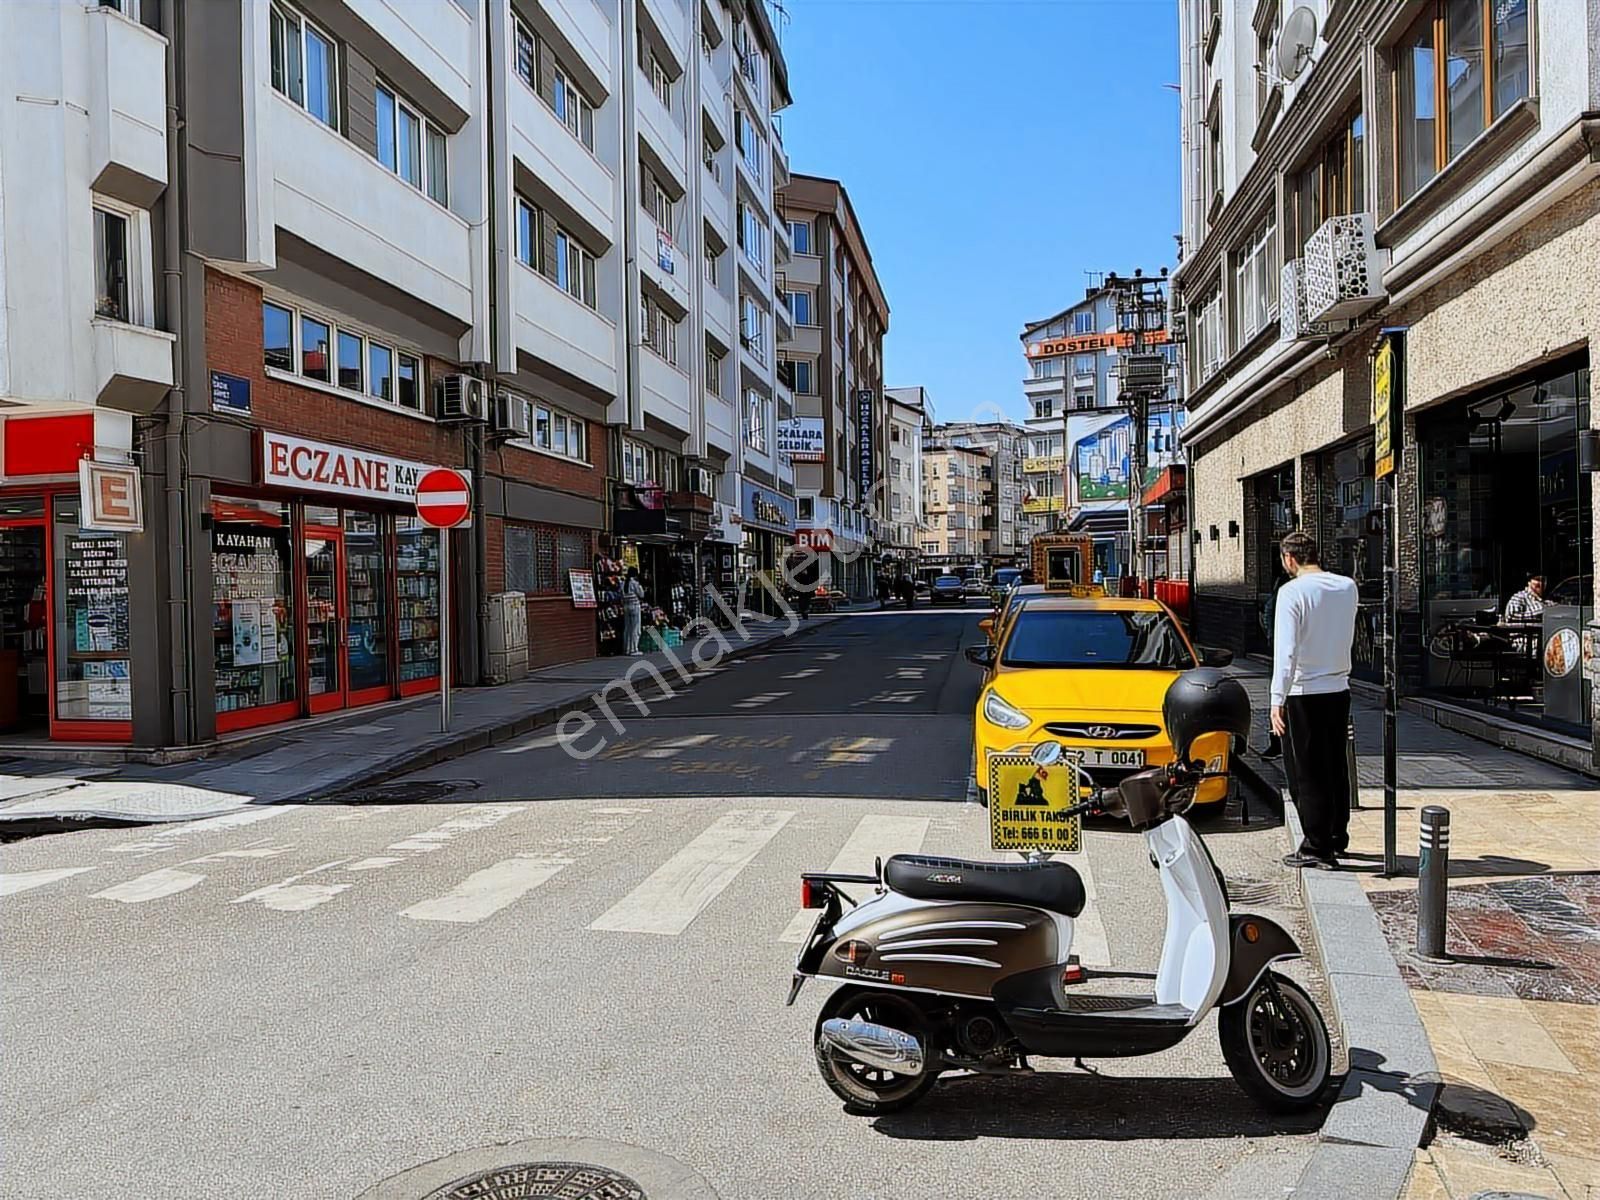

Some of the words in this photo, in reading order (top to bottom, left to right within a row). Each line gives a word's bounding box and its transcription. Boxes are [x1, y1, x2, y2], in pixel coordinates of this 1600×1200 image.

[269, 440, 390, 492] ECZANE
[100, 476, 130, 517] E
[216, 533, 271, 548] KAYAHAN
[799, 530, 830, 547] BİM
[1094, 751, 1104, 764] T
[1111, 751, 1142, 765] 0041
[1001, 807, 1037, 821] BİRLİK
[1002, 826, 1019, 840] Tel:
[1021, 827, 1039, 840] 666
[1042, 827, 1053, 840] 61
[1056, 828, 1069, 841] 00
